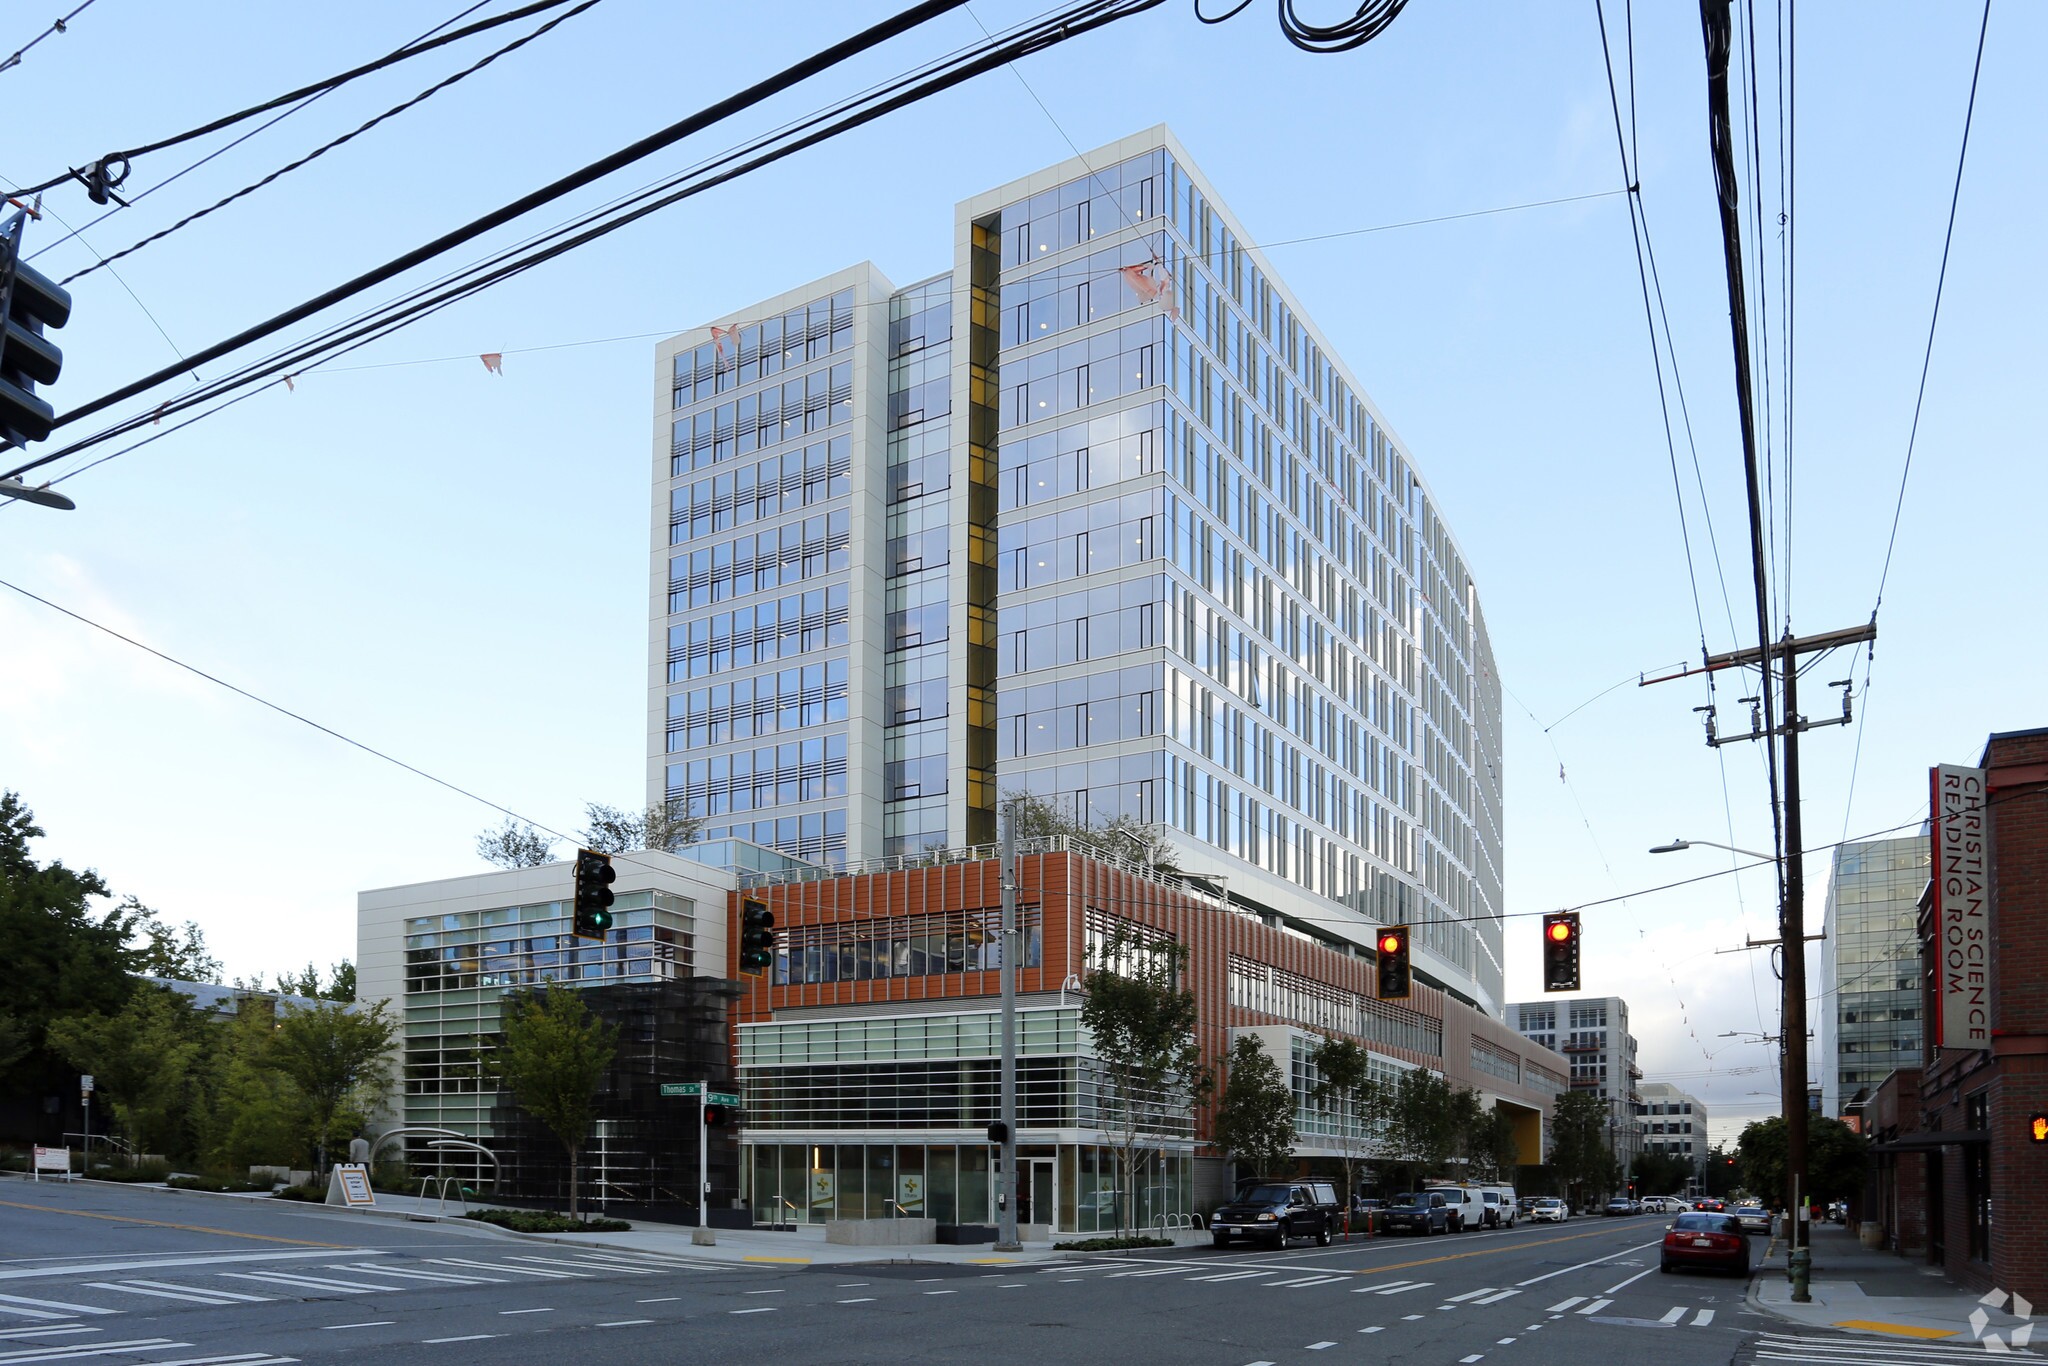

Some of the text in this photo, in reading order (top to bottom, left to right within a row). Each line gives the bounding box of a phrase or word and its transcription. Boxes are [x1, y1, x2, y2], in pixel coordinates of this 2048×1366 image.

[1945, 774, 1964, 993] READING ROOM
[1964, 776, 1985, 1039] CHRISTIAN SCIENCE
[663, 1085, 686, 1094] Thomas
[707, 1093, 718, 1102] 9th
